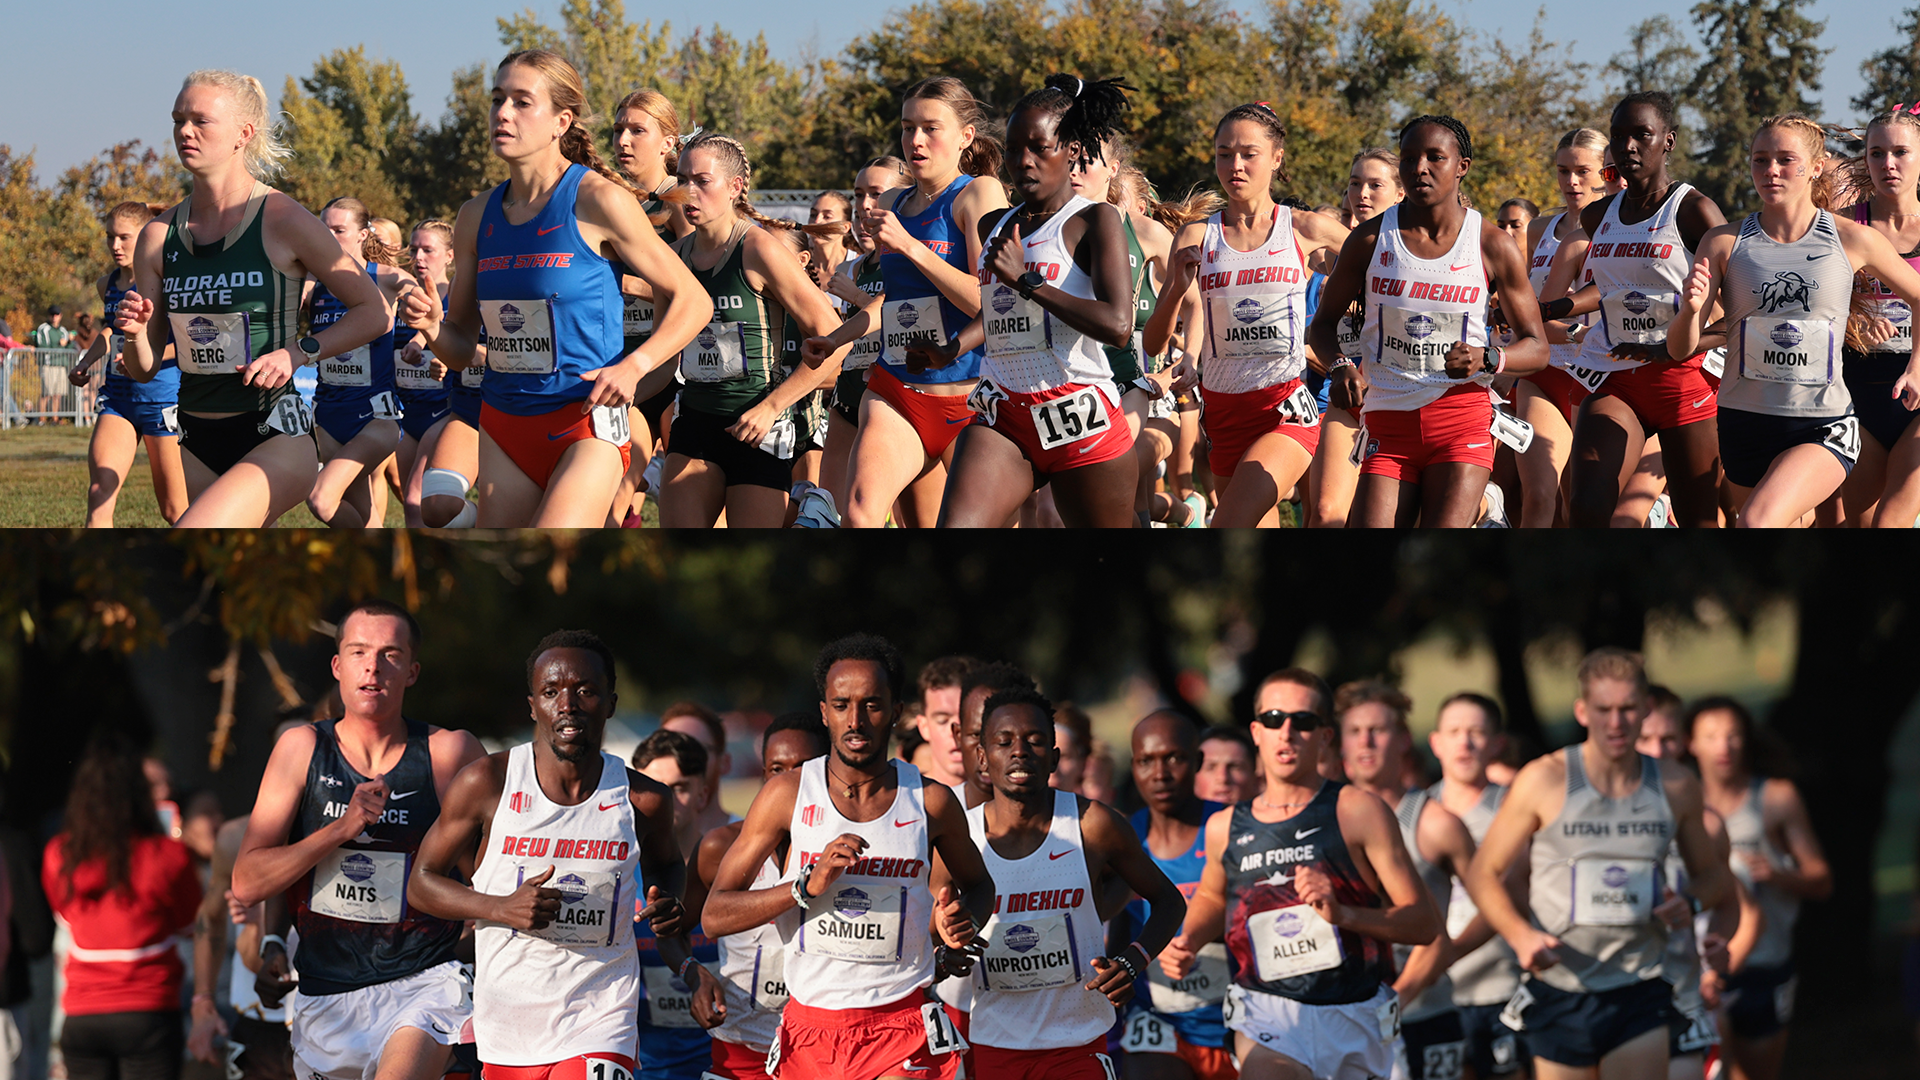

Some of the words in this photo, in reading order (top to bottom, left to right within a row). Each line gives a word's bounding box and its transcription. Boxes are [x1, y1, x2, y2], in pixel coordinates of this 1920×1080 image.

[1613, 243, 1673, 259] MEXICO
[513, 253, 574, 268] STATE
[1201, 271, 1232, 292] NEW
[1236, 266, 1300, 286] MEXICO
[1372, 276, 1404, 297] NEW
[1408, 282, 1480, 304] MEXICO
[169, 289, 232, 310] STATE
[314, 312, 329, 324] AIR
[988, 317, 1030, 336] KIRAREI
[1623, 318, 1656, 331] RONO
[1225, 326, 1278, 342] JANSEN
[489, 336, 550, 352] ROBERTSON
[190, 348, 225, 364] BERG
[698, 352, 719, 366] MAY
[1763, 350, 1808, 366] MOON
[326, 363, 363, 375] HARDEN
[397, 368, 430, 378] FETTERO
[1038, 392, 1106, 443] 152
[1829, 420, 1859, 454] 21
[1563, 822, 1610, 838] UTAH
[1617, 821, 1668, 836] STATE
[502, 836, 550, 857] NEW
[553, 839, 629, 860] MEXICO
[846, 856, 924, 878] MEXICO
[1240, 853, 1262, 872] AIR
[1266, 844, 1314, 866] FORCE
[335, 883, 376, 902] NATS
[1006, 888, 1084, 913] MEXICO
[1592, 892, 1639, 905] HOGAN
[556, 908, 605, 926] LAGAT
[818, 919, 885, 940] SAMUEL
[1274, 938, 1318, 959] ALLEN
[987, 950, 1069, 973] KIPROTICH
[1170, 975, 1209, 992] KUYO
[1130, 1015, 1163, 1046] 59
